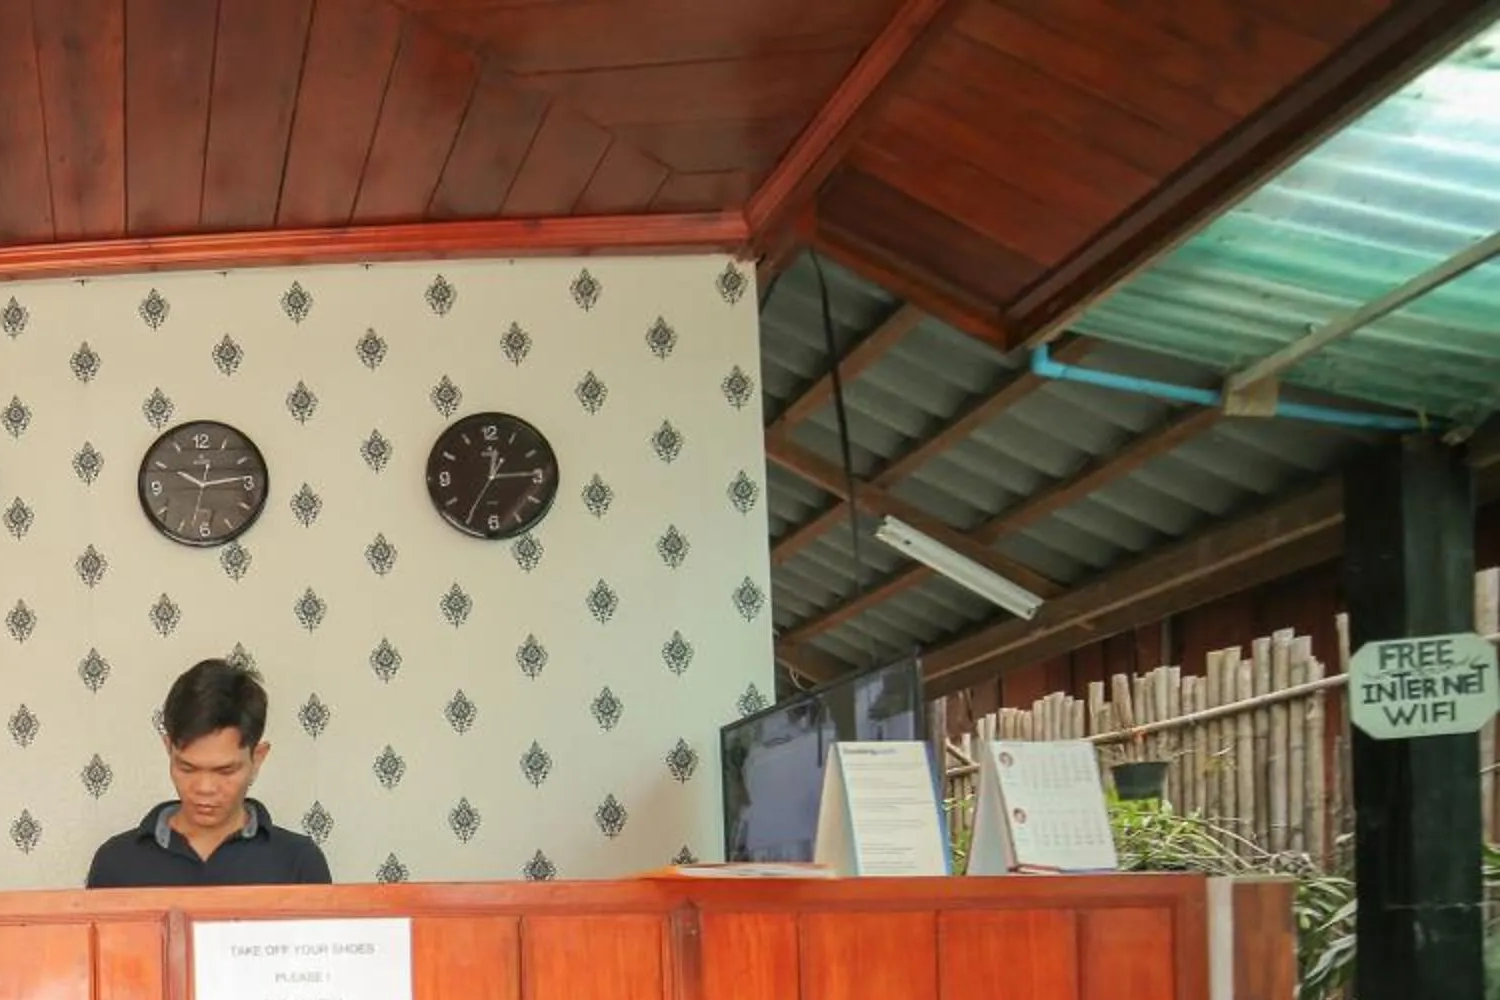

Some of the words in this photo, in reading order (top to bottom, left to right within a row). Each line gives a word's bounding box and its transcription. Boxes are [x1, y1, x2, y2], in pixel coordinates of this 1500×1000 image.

[481, 425, 498, 441] 12
[192, 434, 210, 448] 12
[243, 475, 254, 490] 3
[439, 471, 451, 487] 9
[151, 481, 162, 496] 9
[199, 522, 211, 537] 6
[487, 515, 499, 530] 6
[1379, 640, 1455, 670] FREE
[1361, 664, 1489, 704] INTERNET
[1383, 701, 1455, 726] WIFI
[231, 945, 261, 957] TAKE
[266, 944, 289, 956] OFF
[294, 943, 328, 955] YOUR
